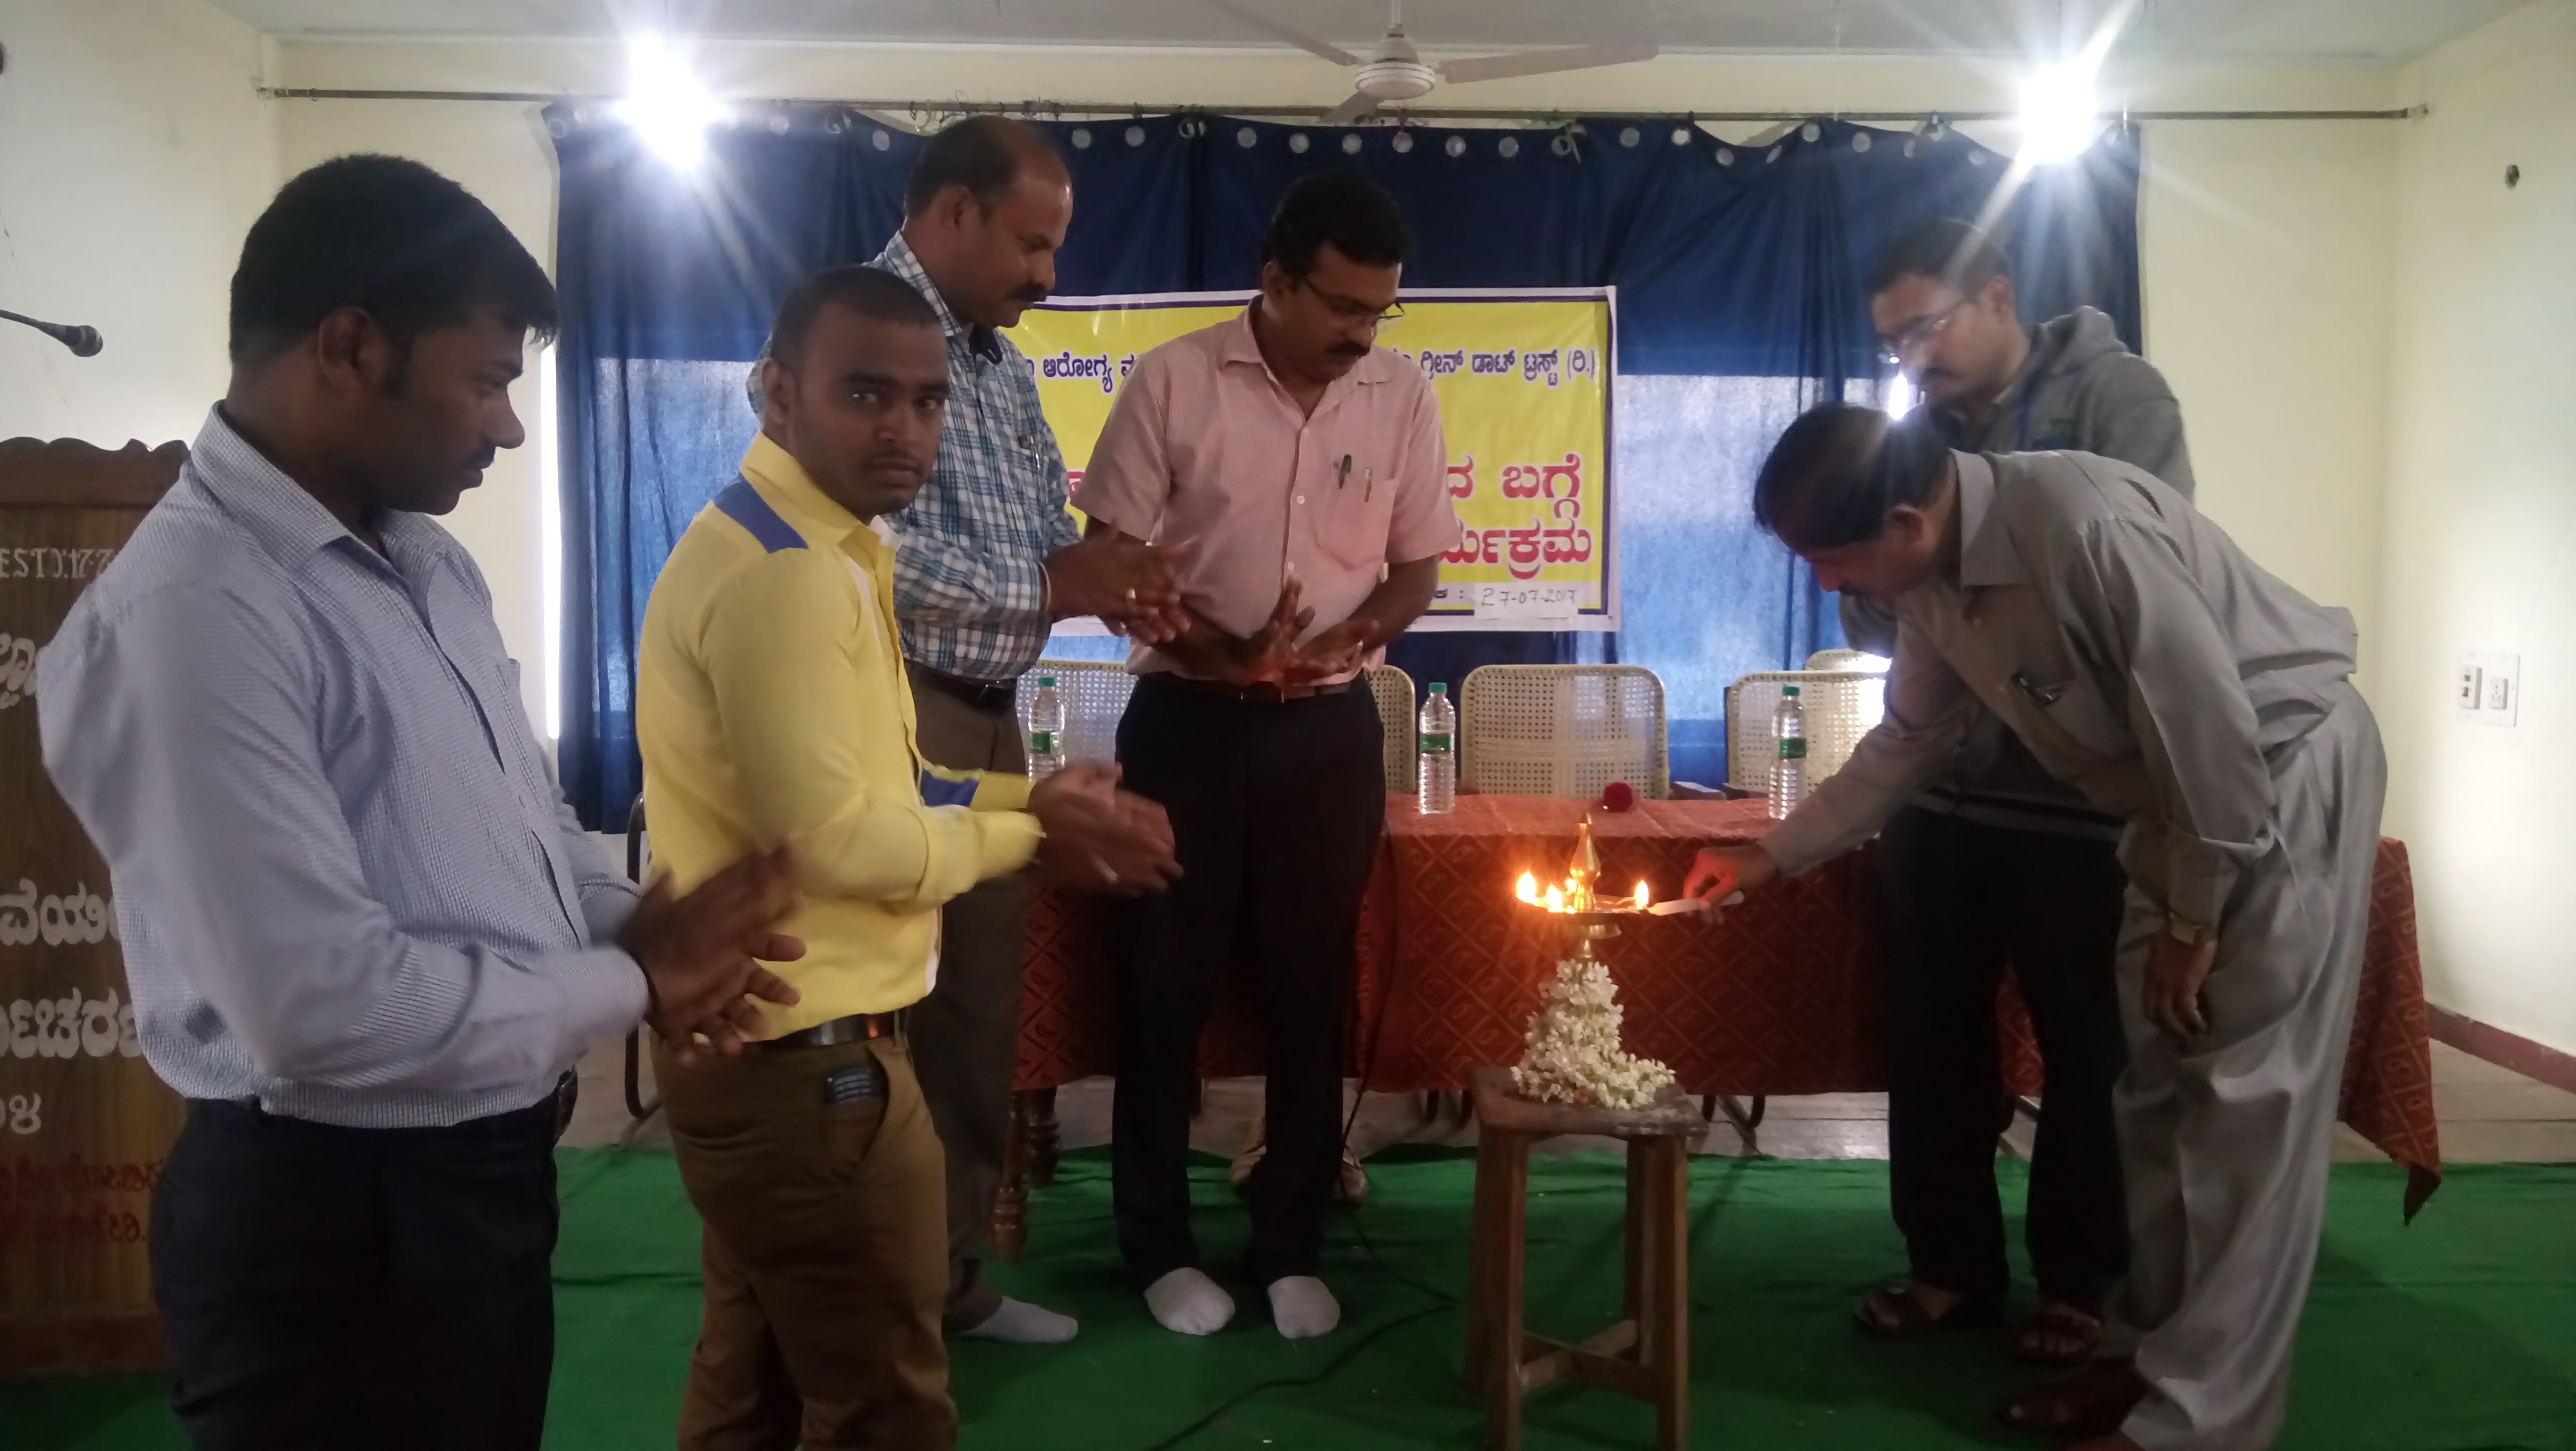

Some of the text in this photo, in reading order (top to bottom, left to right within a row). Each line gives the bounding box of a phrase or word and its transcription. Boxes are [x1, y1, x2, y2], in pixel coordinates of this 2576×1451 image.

[1043, 352, 1113, 393] ಆರೋಗ್ಯ
[1471, 350, 1515, 373] ಡಾಟ್
[1523, 349, 1558, 386] ಟ್ರಸ್ಟ್
[1502, 453, 1580, 518] ಬಗ್ಗೆ
